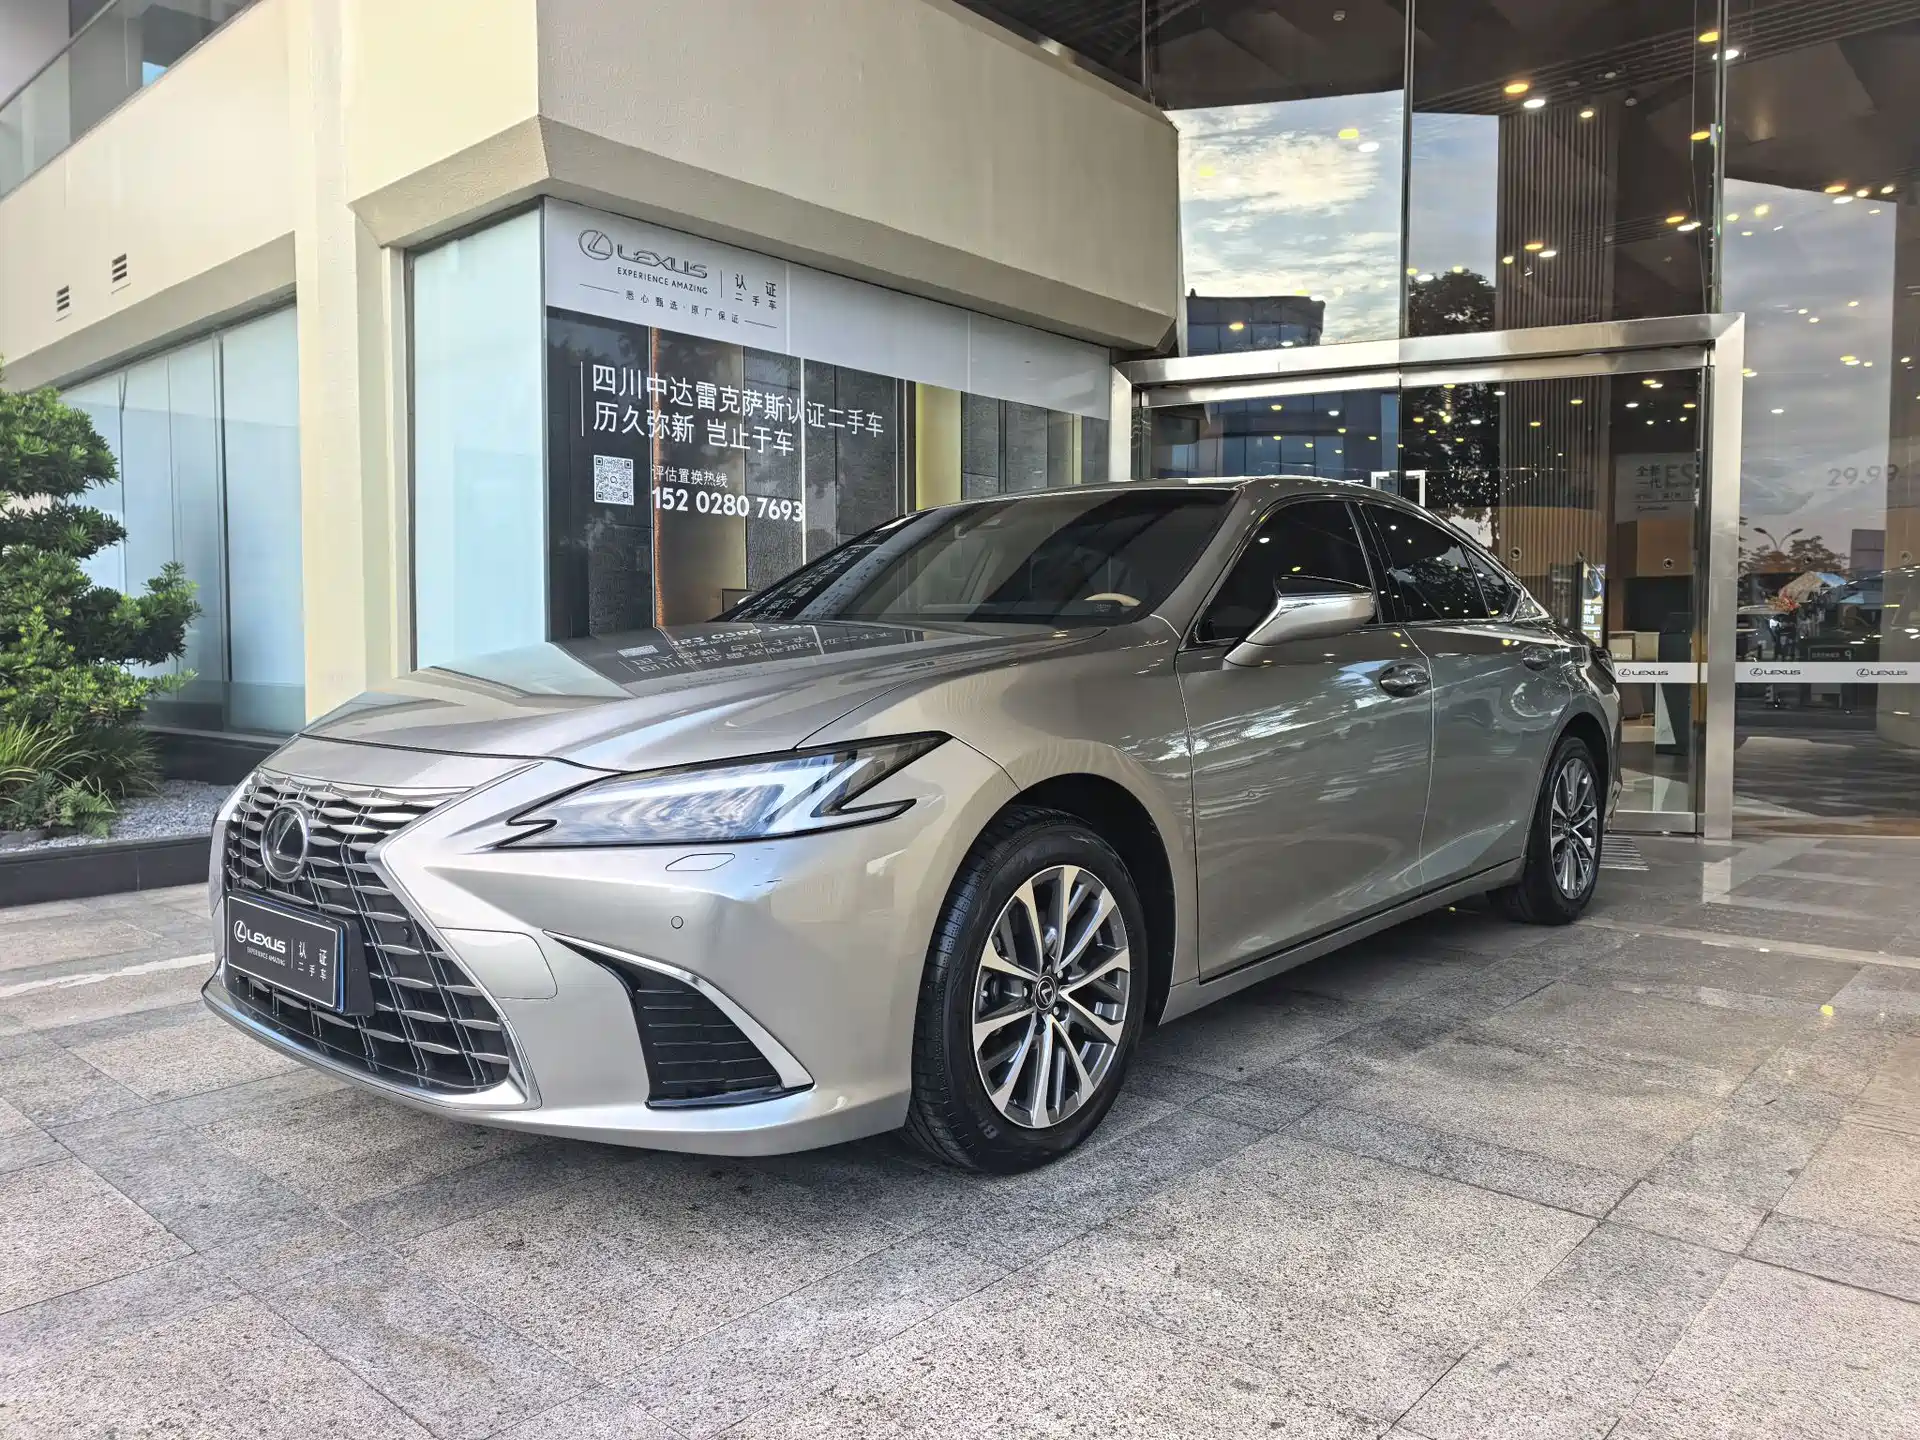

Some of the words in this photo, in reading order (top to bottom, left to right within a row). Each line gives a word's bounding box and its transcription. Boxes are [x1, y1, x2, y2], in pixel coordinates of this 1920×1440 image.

[617, 243, 708, 279] LEXUS
[617, 266, 669, 286] EXPERIENCE
[671, 281, 708, 295] AMAZING
[593, 364, 884, 438] 四川中达雷克萨斯认证二手车
[593, 400, 695, 444] 历久弥新
[706, 418, 794, 456] 岂止于车
[652, 464, 729, 489] 评估置换热线
[652, 486, 689, 512] 152
[696, 490, 750, 517] 0280
[756, 497, 804, 522] 7693
[247, 929, 286, 954] LEXUS
